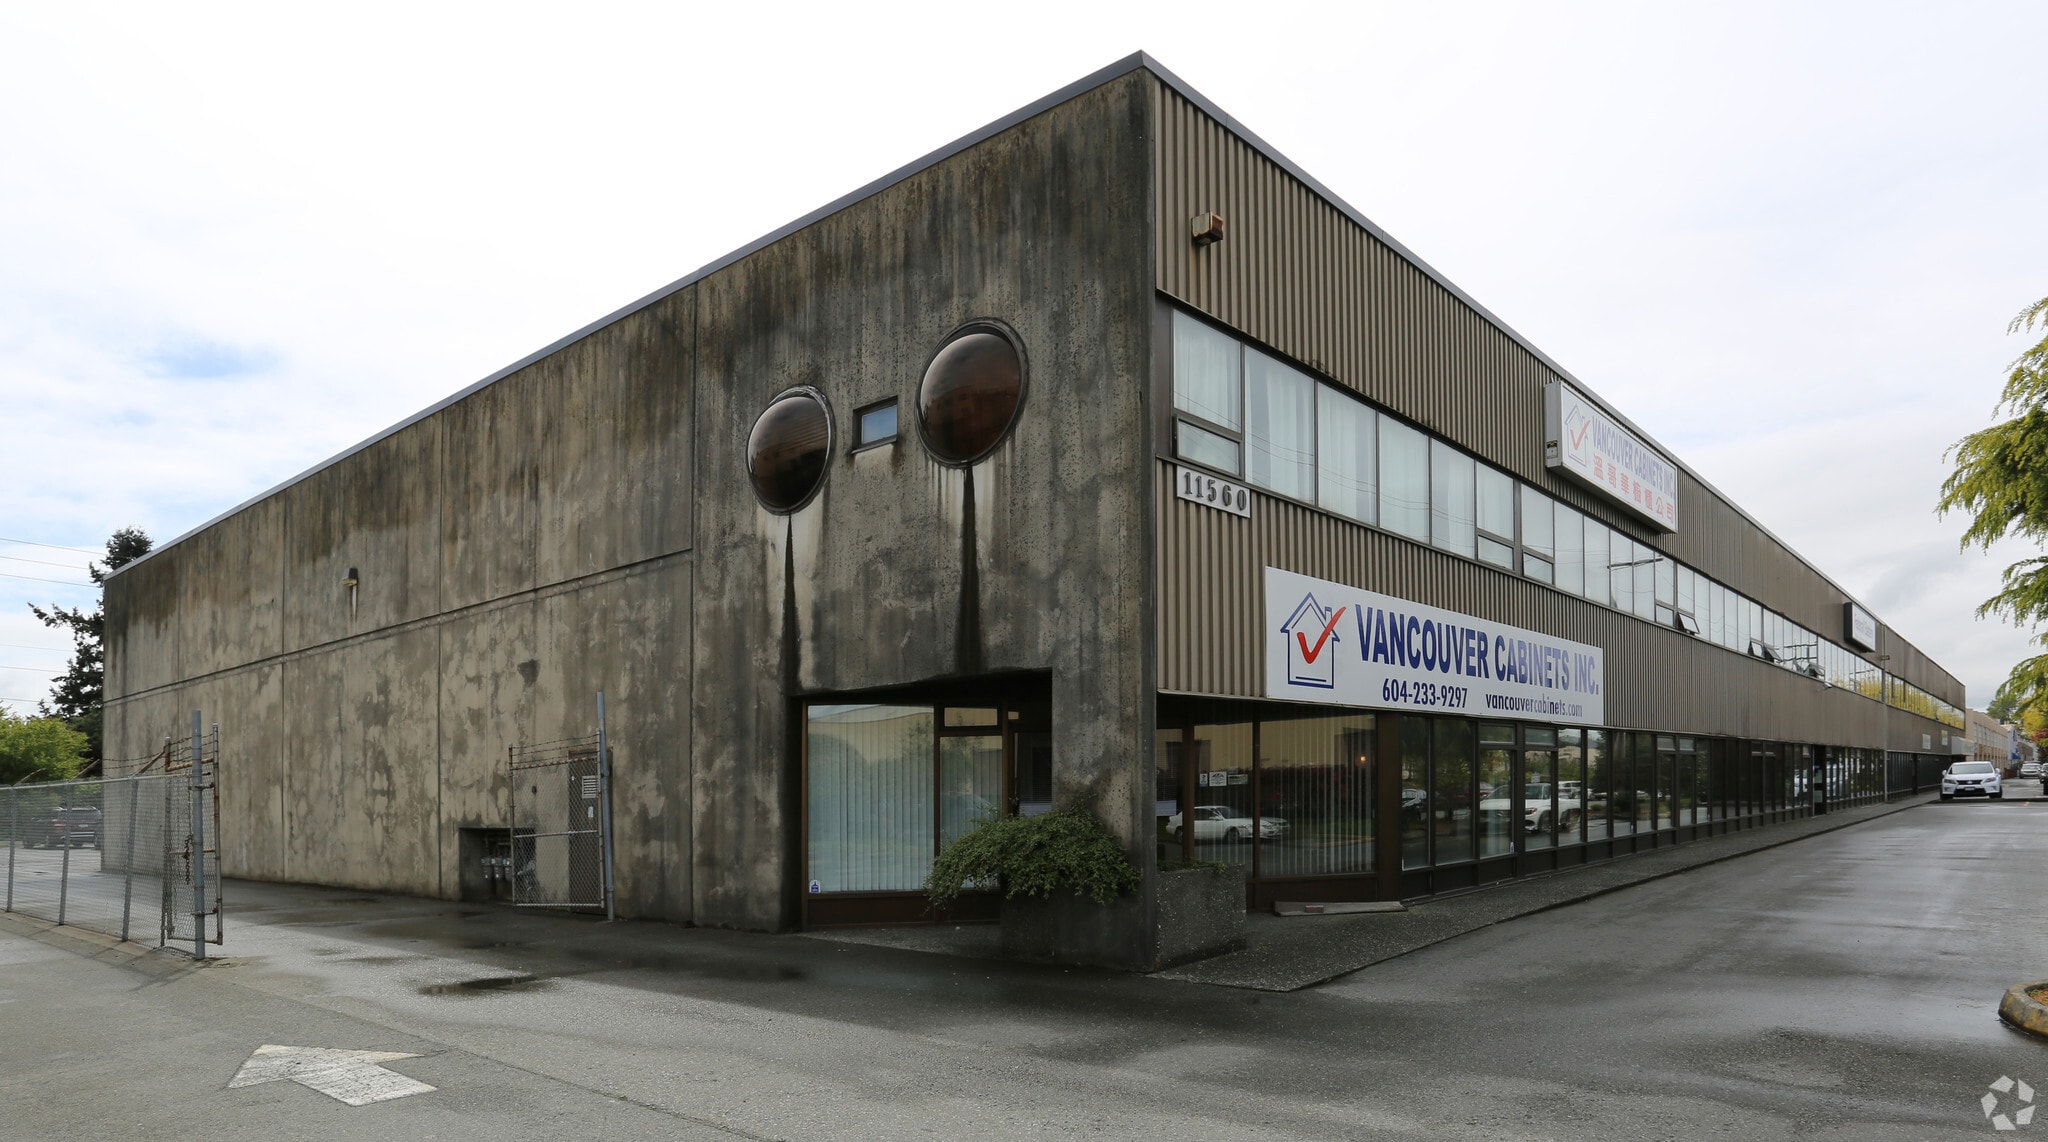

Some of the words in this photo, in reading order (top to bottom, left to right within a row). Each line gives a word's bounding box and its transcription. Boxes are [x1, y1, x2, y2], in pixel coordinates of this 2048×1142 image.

[1592, 416, 1633, 473] VANCOUVER
[1634, 447, 1664, 491] CABINETS
[1184, 472, 1247, 511] 11560
[1355, 604, 1489, 679] VANCOUVER
[1495, 635, 1570, 691] CABINETS
[1574, 652, 1599, 695] INC.
[1382, 678, 1467, 708] 604-233-9297
[1486, 693, 1582, 717] vancouvercabinets.com
